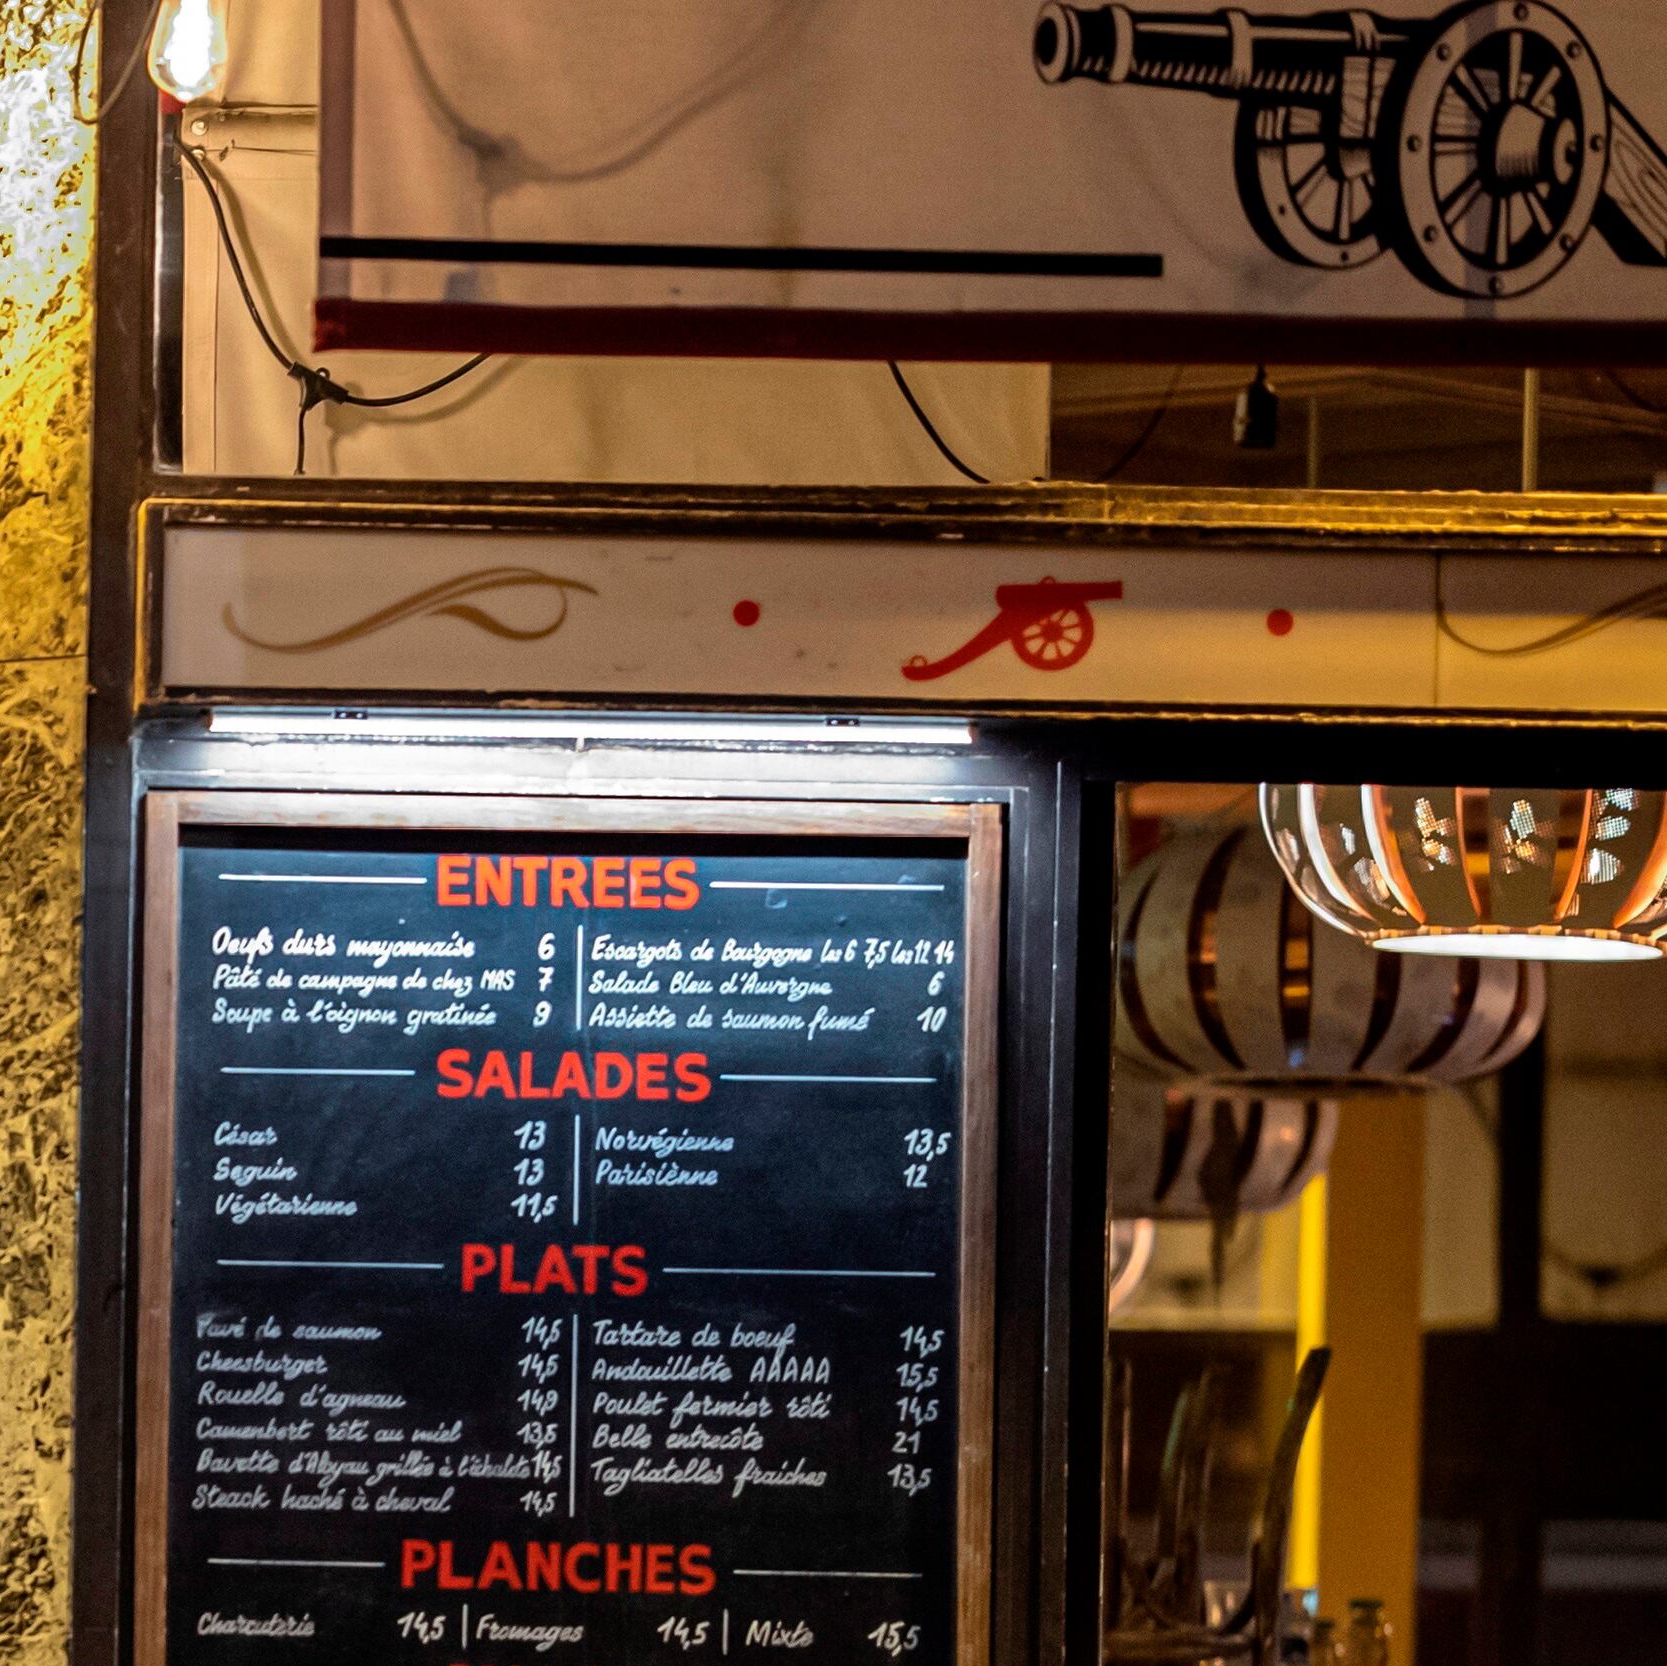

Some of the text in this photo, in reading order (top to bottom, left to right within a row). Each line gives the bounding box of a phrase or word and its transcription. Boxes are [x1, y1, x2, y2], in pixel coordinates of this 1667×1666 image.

[437, 854, 699, 910] ENTREES
[212, 926, 556, 968] Oeufs durs mayonnaise 6
[591, 934, 683, 968] Escargots
[690, 938, 714, 962] de
[721, 938, 812, 968] Bourgogne
[844, 939, 858, 962] 6
[863, 937, 891, 969] 7,5
[914, 939, 932, 964] 12
[934, 940, 955, 964] 14
[212, 963, 554, 997] Pâté de campagne de chez MAS 7
[588, 971, 945, 1002] Salade Bleu d'Auvergne 6
[212, 997, 552, 1035] Soupe à l'oignon gratinée 9
[588, 1002, 948, 1041] Assiette de saumon fumé 10
[436, 1048, 711, 1103] SALADES
[213, 1119, 547, 1150] César 13
[595, 1127, 952, 1162] Norvégienne 13,5
[213, 1156, 545, 1187] Seguin 13
[903, 1164, 928, 1188] 12
[215, 1192, 559, 1224] Végétarienne 11,5
[461, 1243, 649, 1297] PLATS
[196, 1312, 564, 1351] Pavé de saumon 14,5
[592, 1318, 946, 1359] Tartare de boeuf 14,5
[517, 1353, 560, 1384] 14,5
[591, 1355, 940, 1392] Andouillette AAAAA 15,5
[197, 1380, 559, 1419] Rouelle d'agneau 14,9
[592, 1390, 940, 1429] Poulet fermier rôti 14,5
[195, 1416, 560, 1450] Camembert rôti au miel 13,5
[591, 1421, 922, 1454] Belle entrecôte 21
[195, 1447, 279, 1475] Bavette
[366, 1449, 436, 1487] grillée
[438, 1455, 454, 1478] à
[589, 1456, 724, 1497] Tagliatelles
[886, 1463, 933, 1497] 13,5
[191, 1483, 558, 1518] Steack haché à cheval 14,5
[401, 1539, 717, 1596] PLANCHES
[197, 1611, 446, 1645] Charcuterie 14,5
[475, 1613, 711, 1652] Fromages 14,5
[745, 1619, 922, 1657] Mixte 15,5
